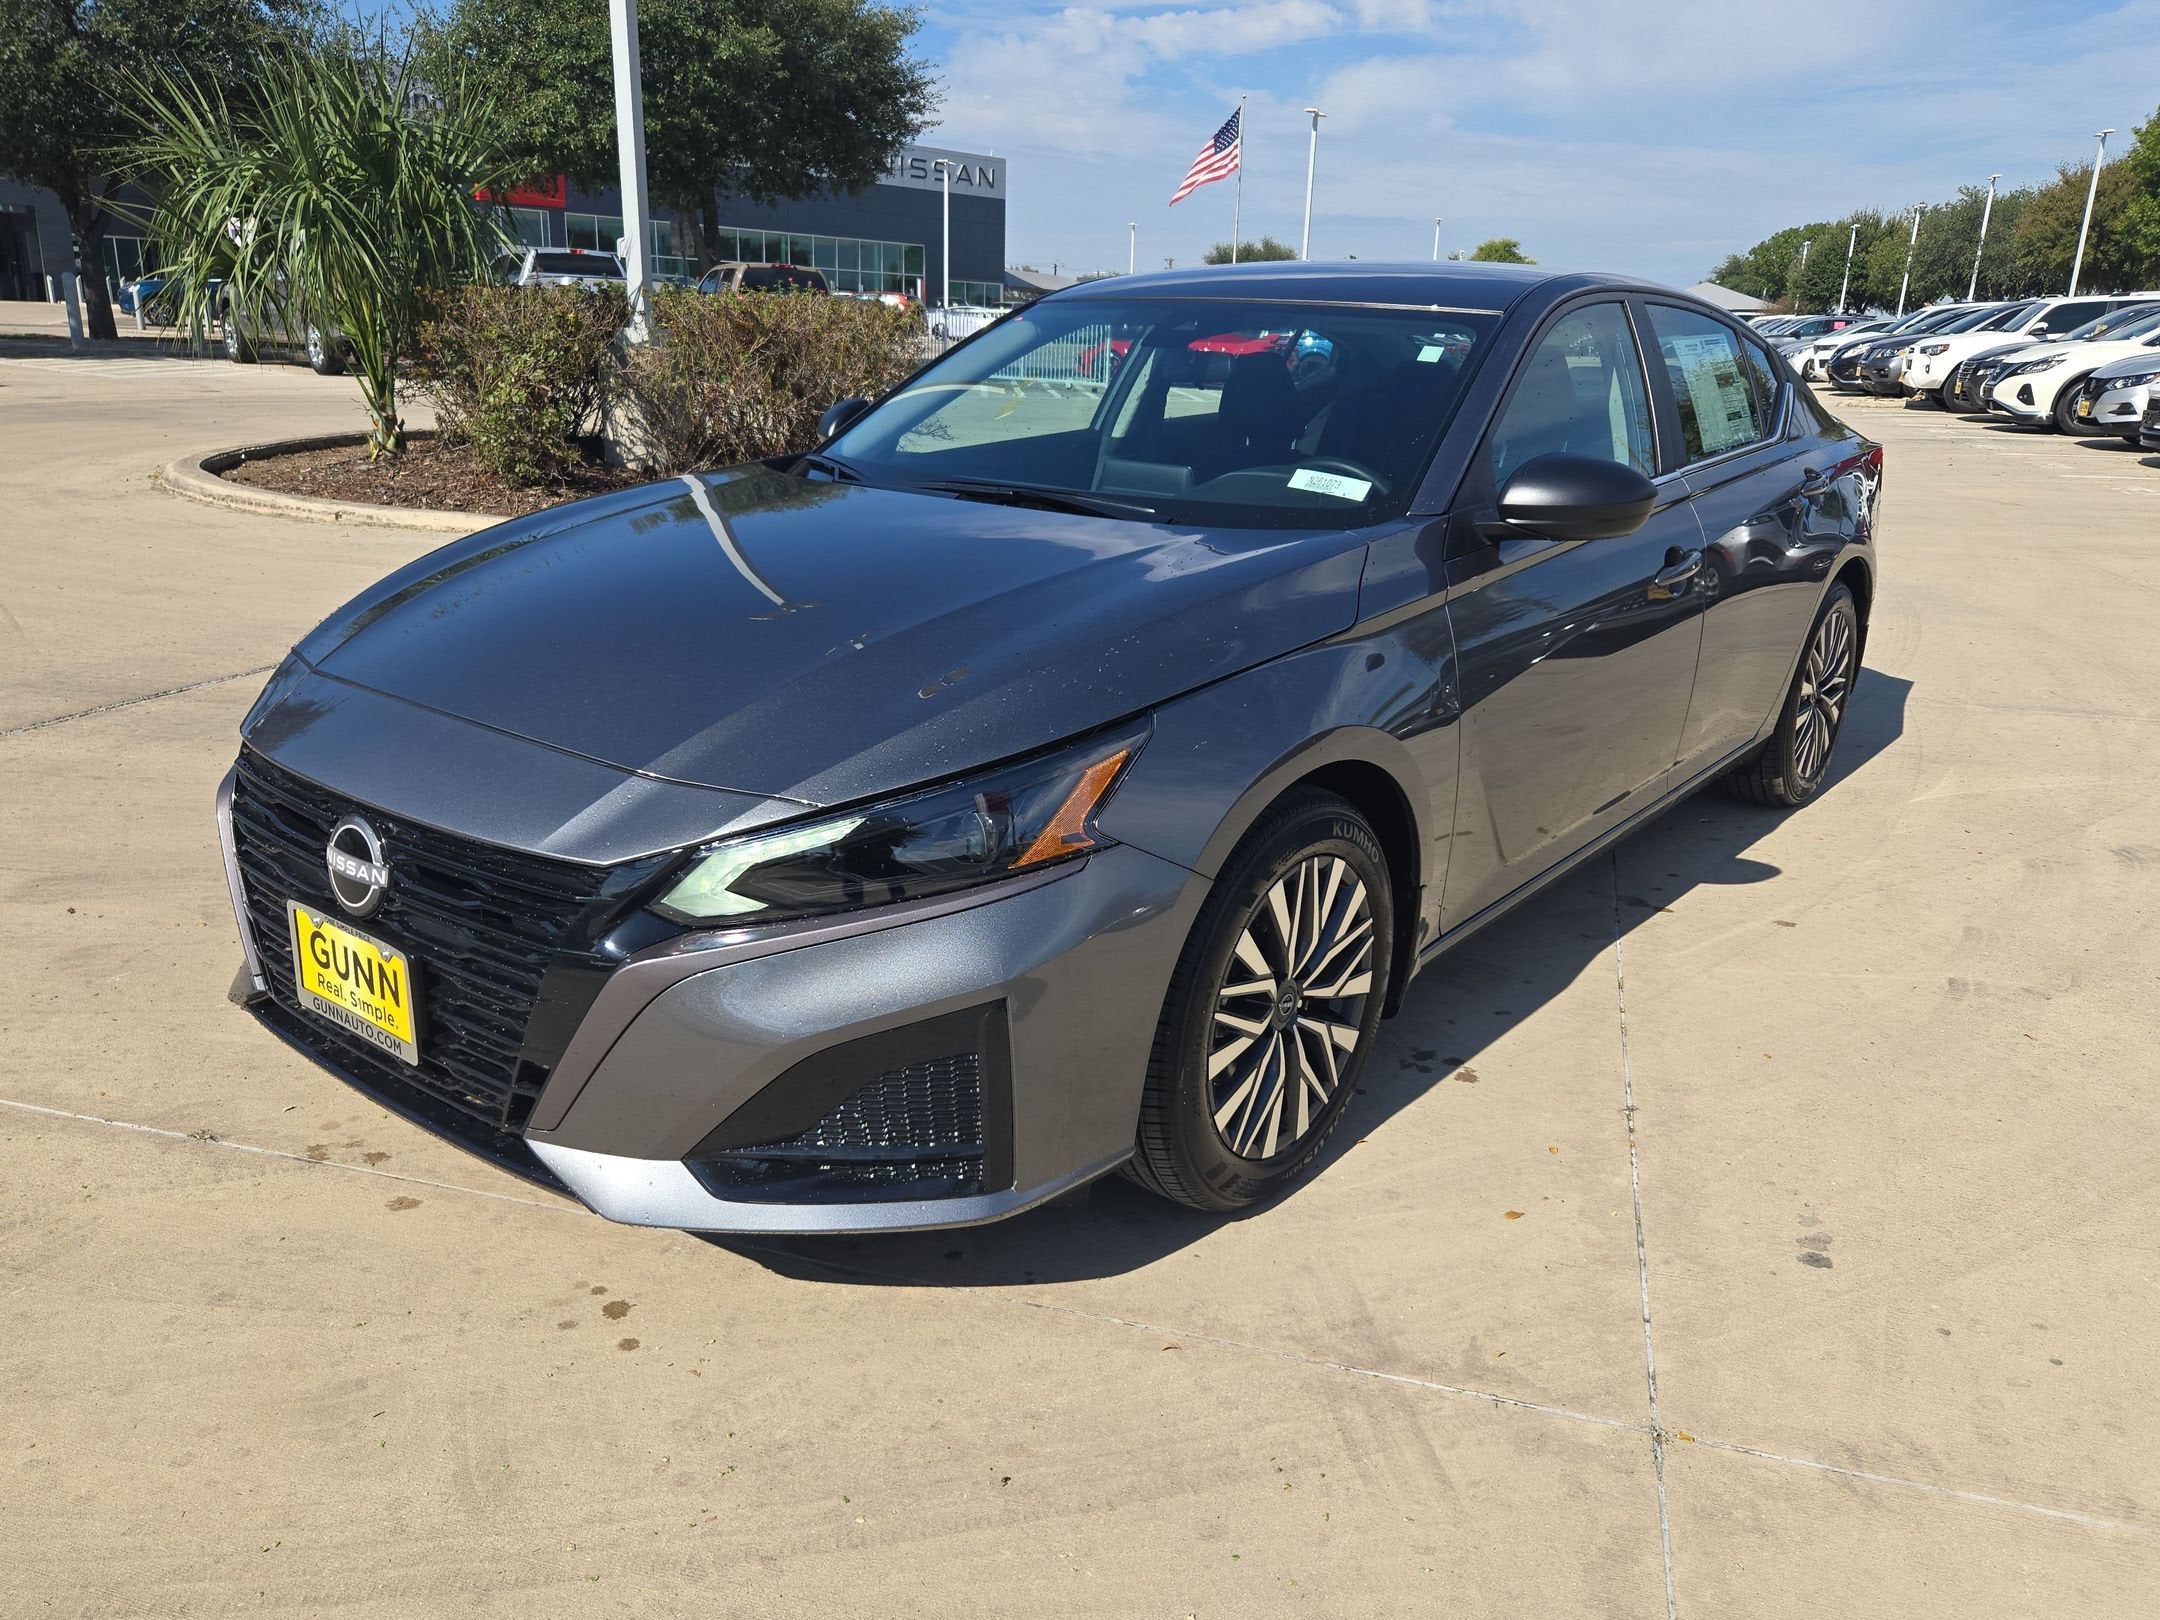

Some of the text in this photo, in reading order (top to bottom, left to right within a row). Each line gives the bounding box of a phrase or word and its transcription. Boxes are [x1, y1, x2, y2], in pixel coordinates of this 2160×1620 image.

[326, 846, 387, 885] NISSAN
[1332, 821, 1379, 863] KUMHO
[310, 930, 401, 1008] GUNN
[312, 996, 402, 1055] GUNNAUTO.COM
[317, 973, 399, 1030] Real. Simple.
